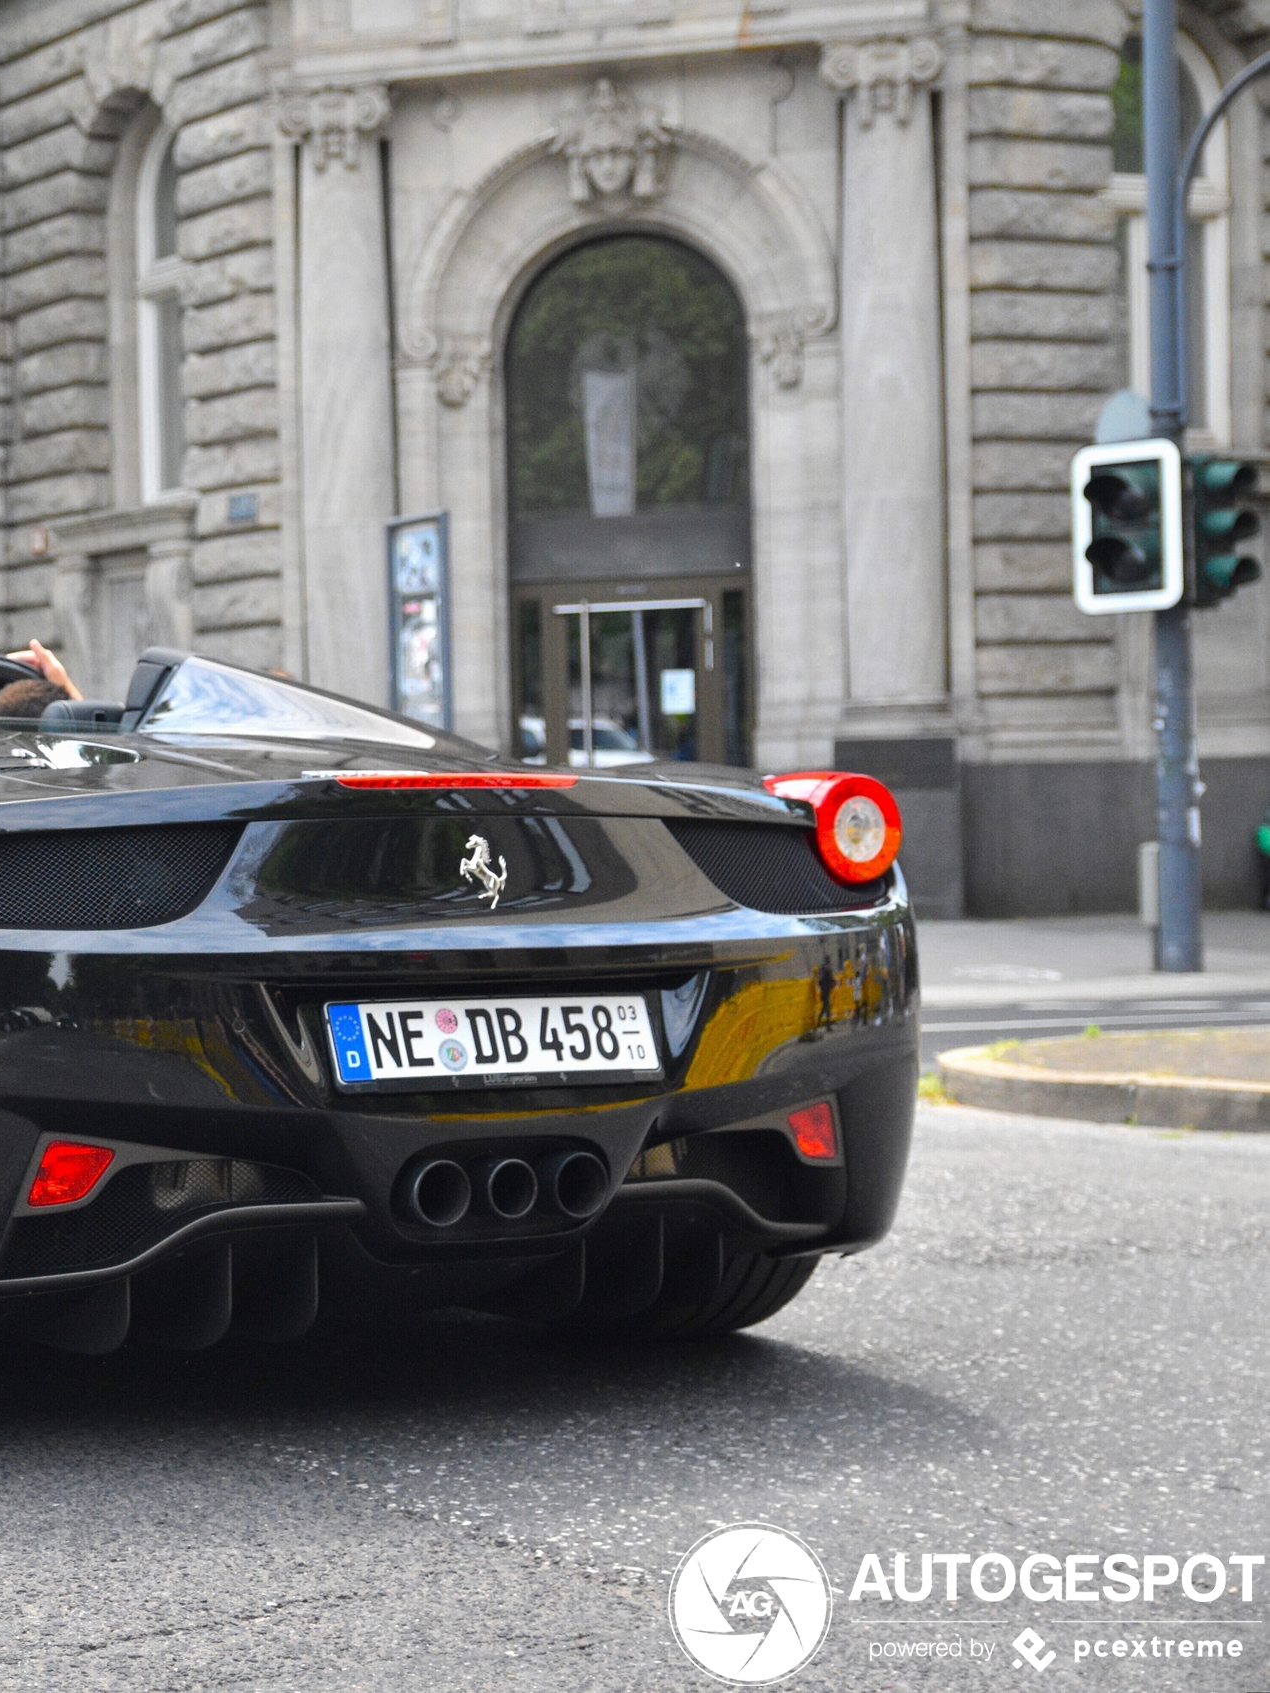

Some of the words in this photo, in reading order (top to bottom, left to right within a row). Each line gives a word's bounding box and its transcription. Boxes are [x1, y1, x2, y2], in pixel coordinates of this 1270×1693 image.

[617, 1005, 637, 1021] 03
[366, 1011, 435, 1069] NE
[464, 1008, 528, 1064] DB
[539, 1005, 619, 1062] 458
[346, 1051, 361, 1068] D
[627, 1044, 646, 1060] 10
